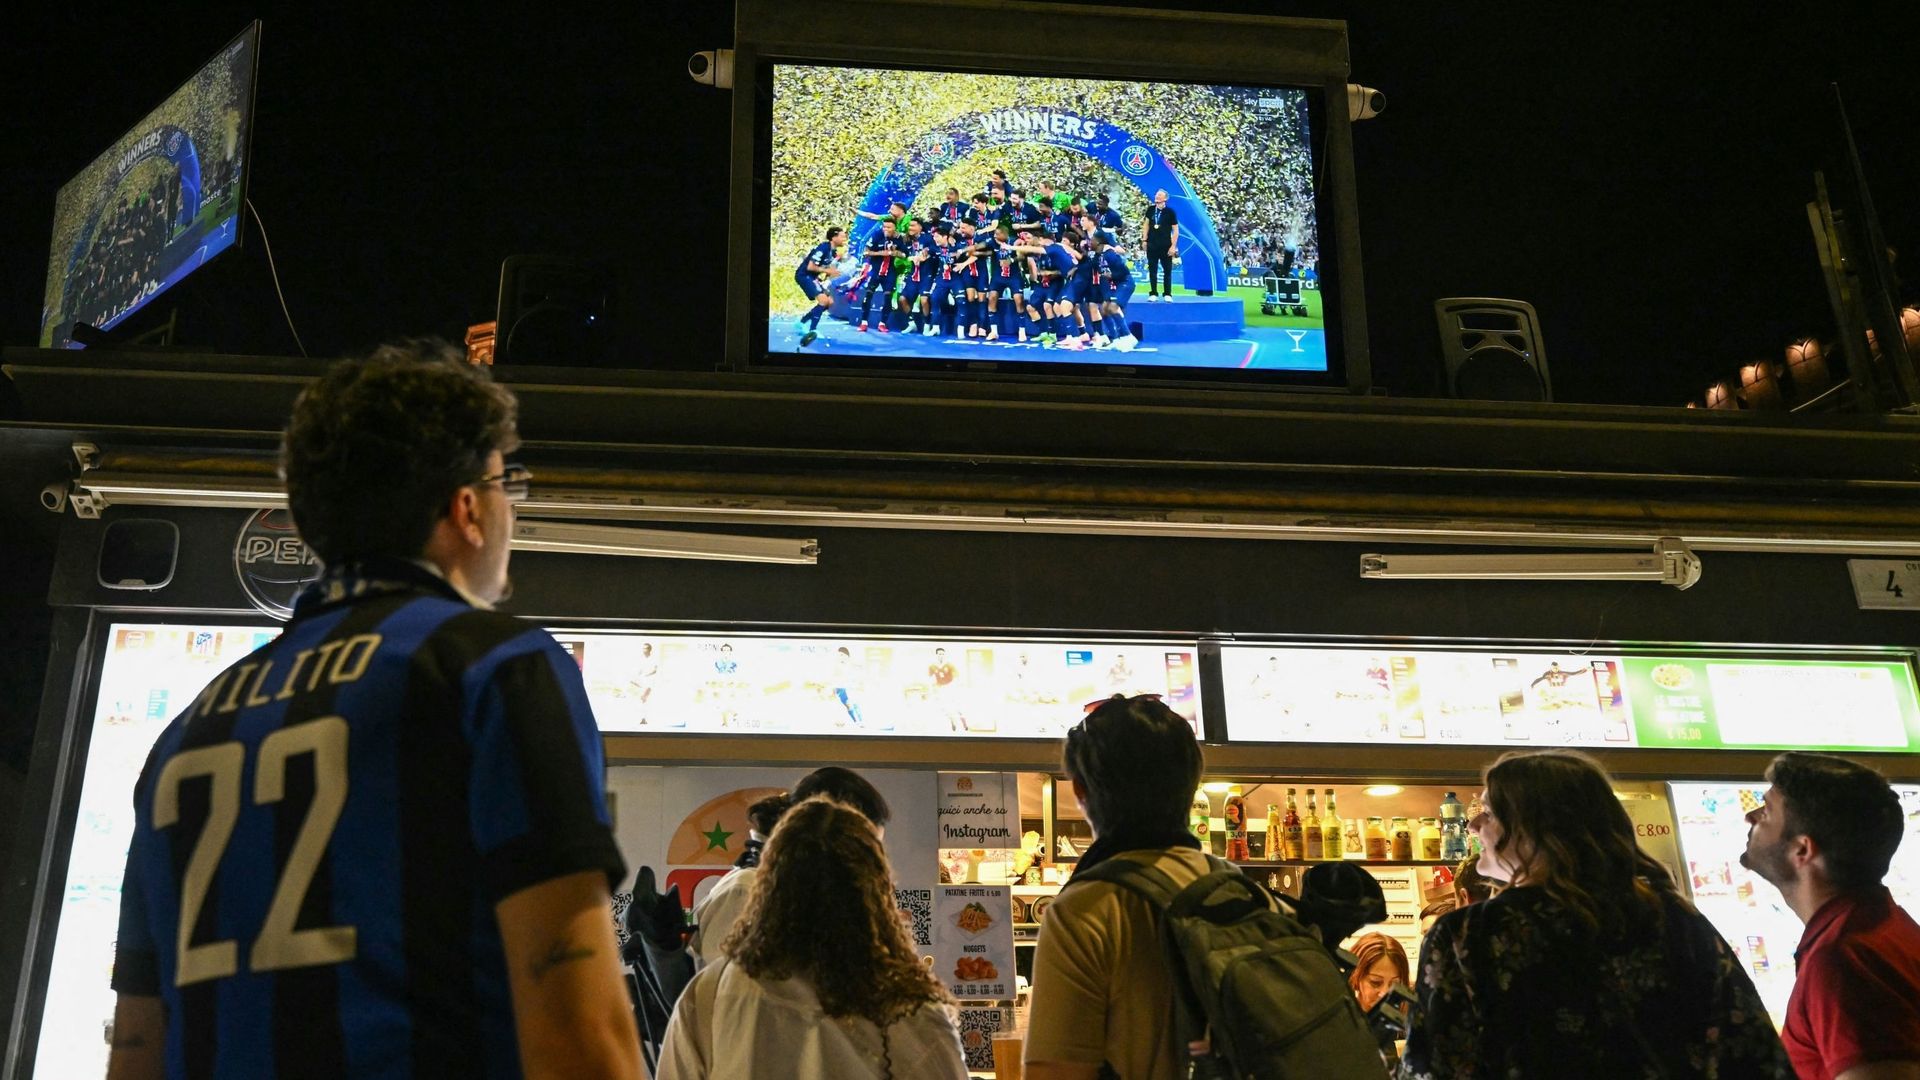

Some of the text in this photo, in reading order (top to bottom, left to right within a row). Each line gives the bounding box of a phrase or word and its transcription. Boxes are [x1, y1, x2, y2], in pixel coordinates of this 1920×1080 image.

[1244, 98, 1258, 106] sky
[979, 109, 1098, 140] WINNERS
[118, 128, 162, 174] WINNERS
[1885, 569, 1904, 598] 4
[183, 634, 383, 727] MILITO
[963, 803, 993, 815] anche
[944, 823, 1011, 843] Instagram
[152, 715, 357, 987] 22
[945, 888, 967, 897] PATATINE
[969, 888, 985, 897] FRITTE
[963, 945, 986, 953] NUGGETS
